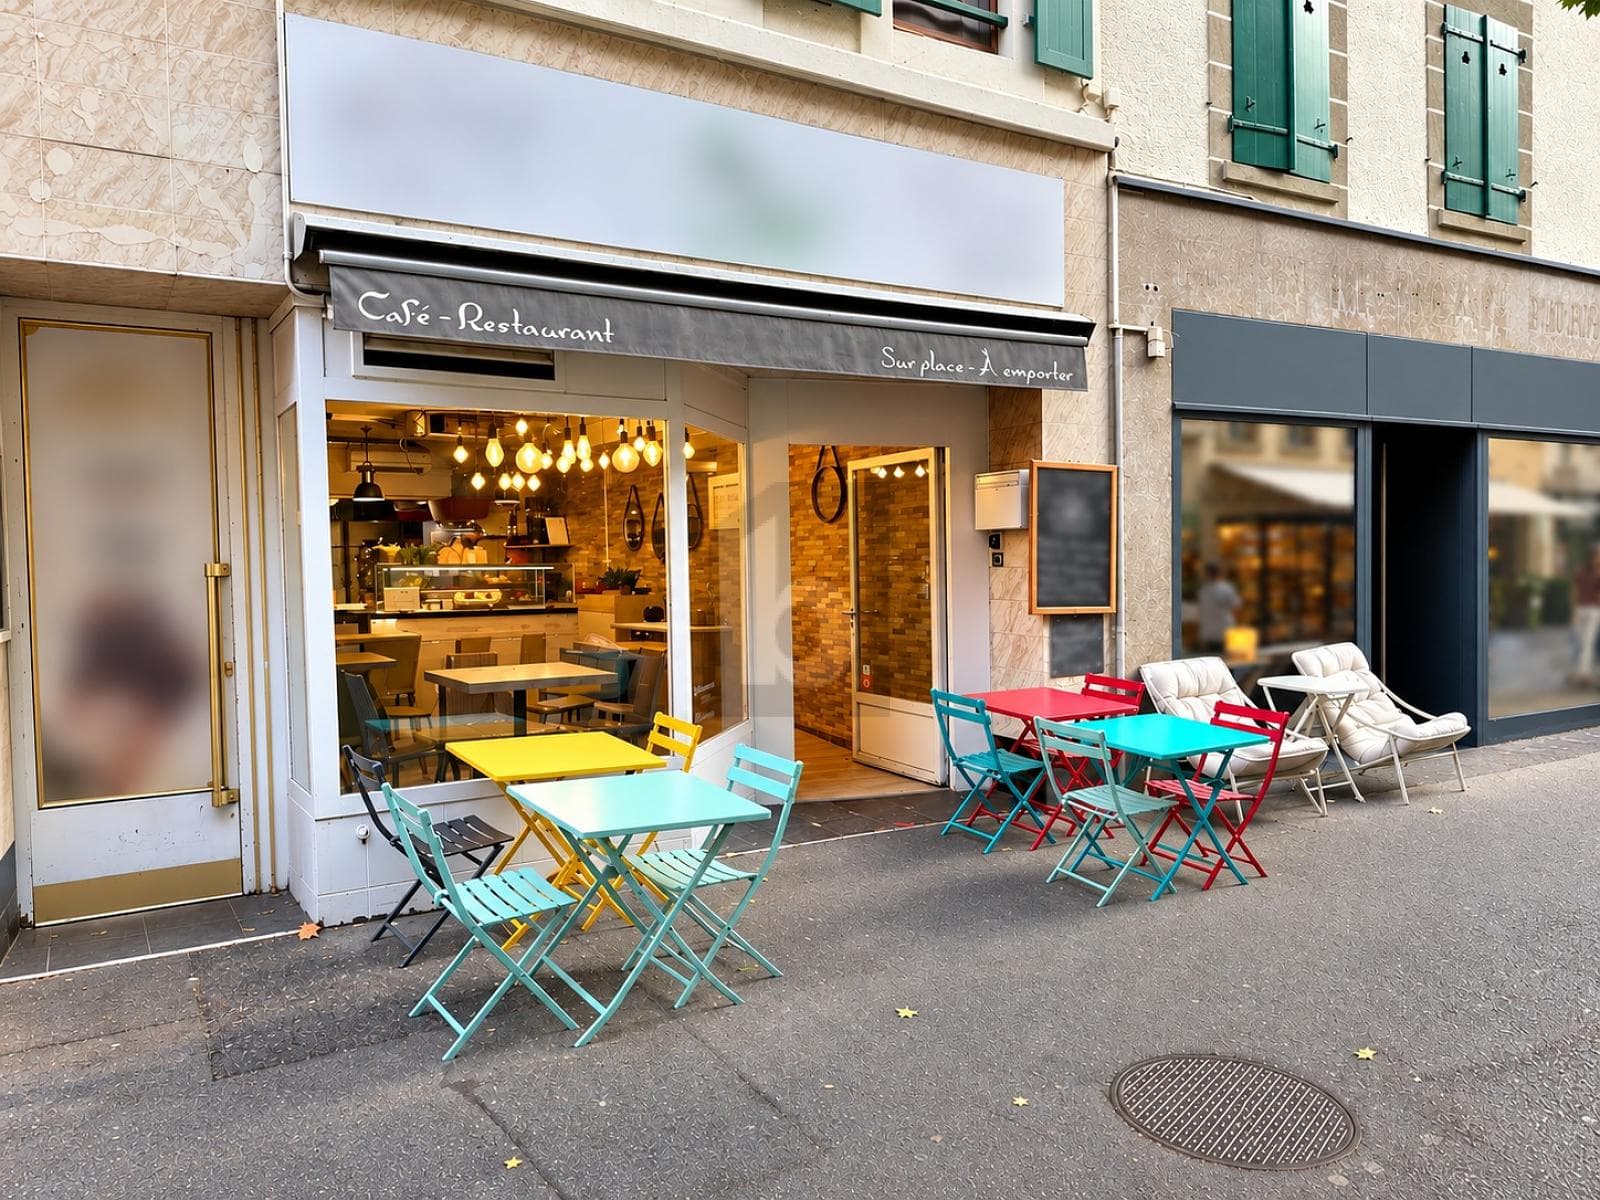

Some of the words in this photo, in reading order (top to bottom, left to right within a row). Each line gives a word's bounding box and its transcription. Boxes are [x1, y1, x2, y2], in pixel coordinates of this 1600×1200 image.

[881, 346, 917, 370] Sur
[919, 349, 965, 378] place
[1003, 361, 1074, 385] emporter
